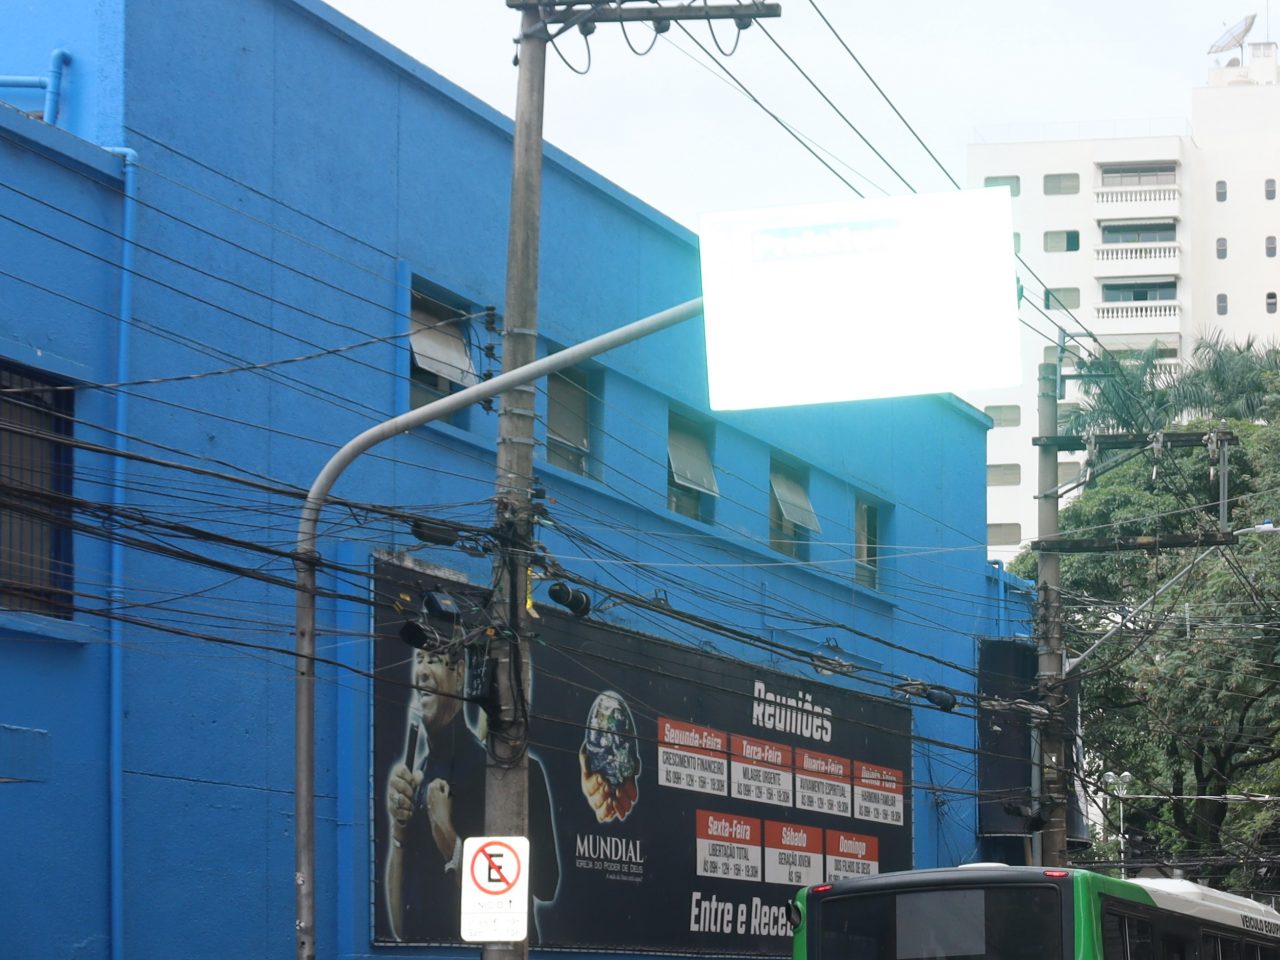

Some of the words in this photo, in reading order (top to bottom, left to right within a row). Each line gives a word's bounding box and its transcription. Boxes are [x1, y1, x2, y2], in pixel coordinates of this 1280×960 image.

[752, 680, 832, 742] Reuniões
[664, 723, 722, 751] Segunda-Feira
[708, 816, 750, 840] Sexta-Feira
[781, 826, 807, 848] Sábado
[576, 833, 644, 863] MUNDIAL
[839, 836, 867, 858] Domingo
[690, 892, 733, 934] Entre
[737, 904, 747, 935] e
